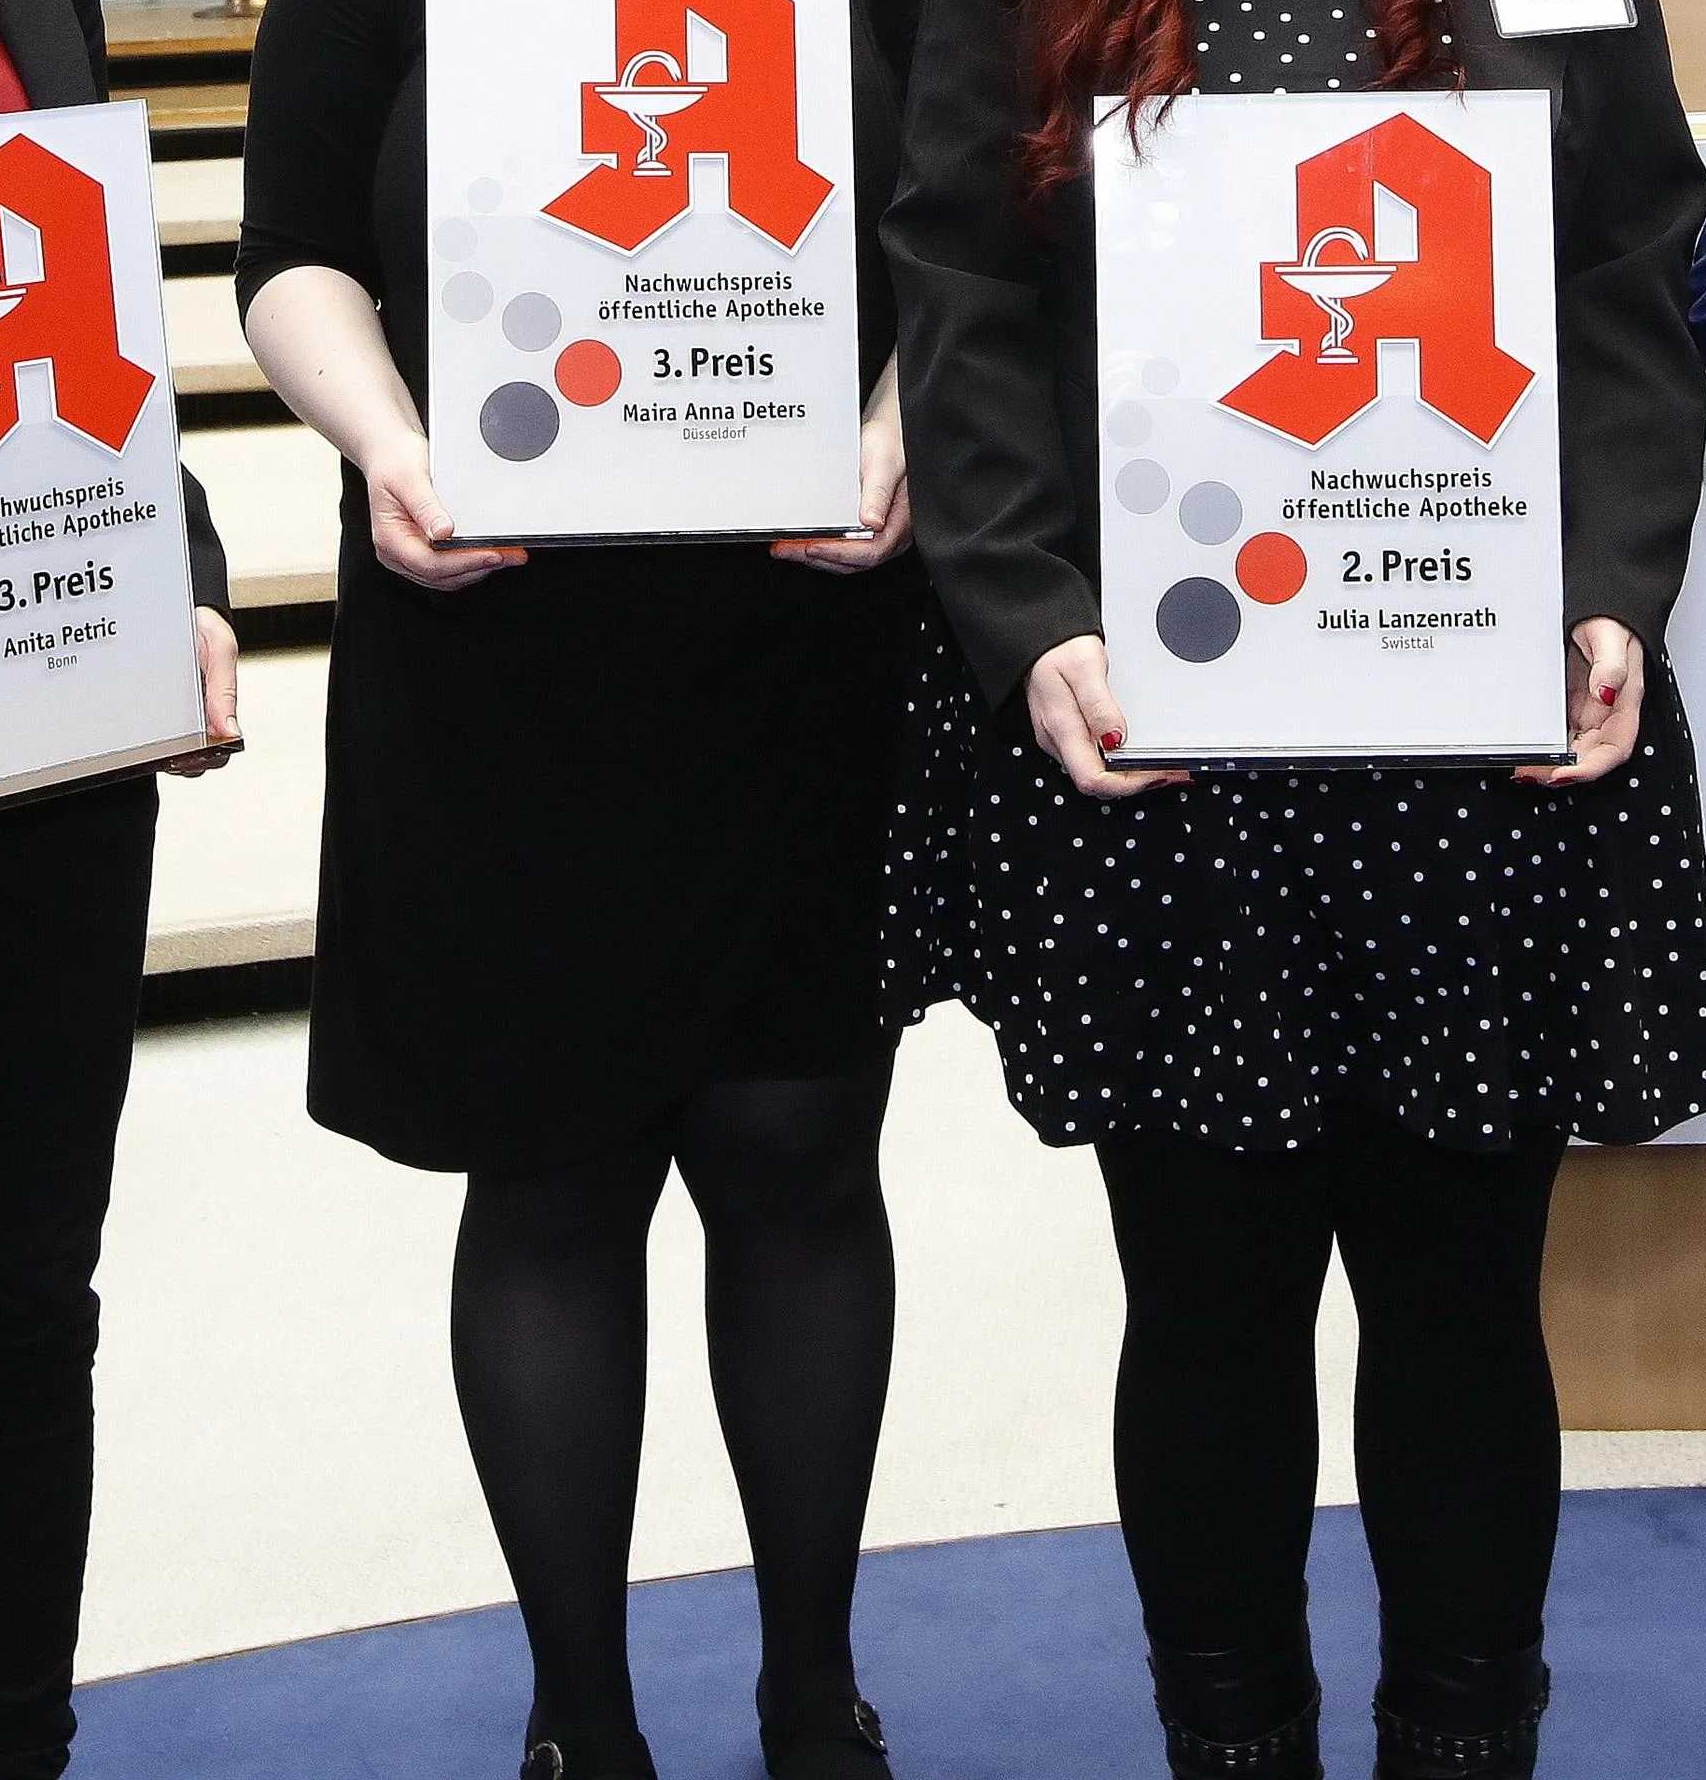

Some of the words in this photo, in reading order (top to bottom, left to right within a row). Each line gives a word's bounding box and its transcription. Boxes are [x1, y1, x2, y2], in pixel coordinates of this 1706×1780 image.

[625, 271, 793, 295] Nachwuchspreis
[598, 300, 717, 320] öffentliche
[725, 298, 825, 322] Apotheke
[653, 348, 683, 378] 3.
[691, 345, 774, 377] Preis
[623, 403, 677, 422] Maira
[684, 402, 735, 421] Anna
[743, 401, 806, 419] Deters
[683, 426, 748, 440] Düsseldorf
[1311, 467, 1492, 493] Nachwuchspreis
[63, 501, 157, 537] Apotheke
[1282, 497, 1410, 519] öffentliche
[1419, 496, 1528, 522] Apotheke
[1342, 551, 1373, 582] 2.
[1382, 548, 1472, 582] Preis
[33, 560, 114, 604] Preis
[1317, 609, 1370, 629] Julia
[1378, 607, 1497, 629] Lanzenrath
[4, 632, 55, 658] Anita
[61, 617, 117, 645] Petric
[1381, 636, 1434, 650] Swisttal
[47, 654, 78, 669] Bonn
